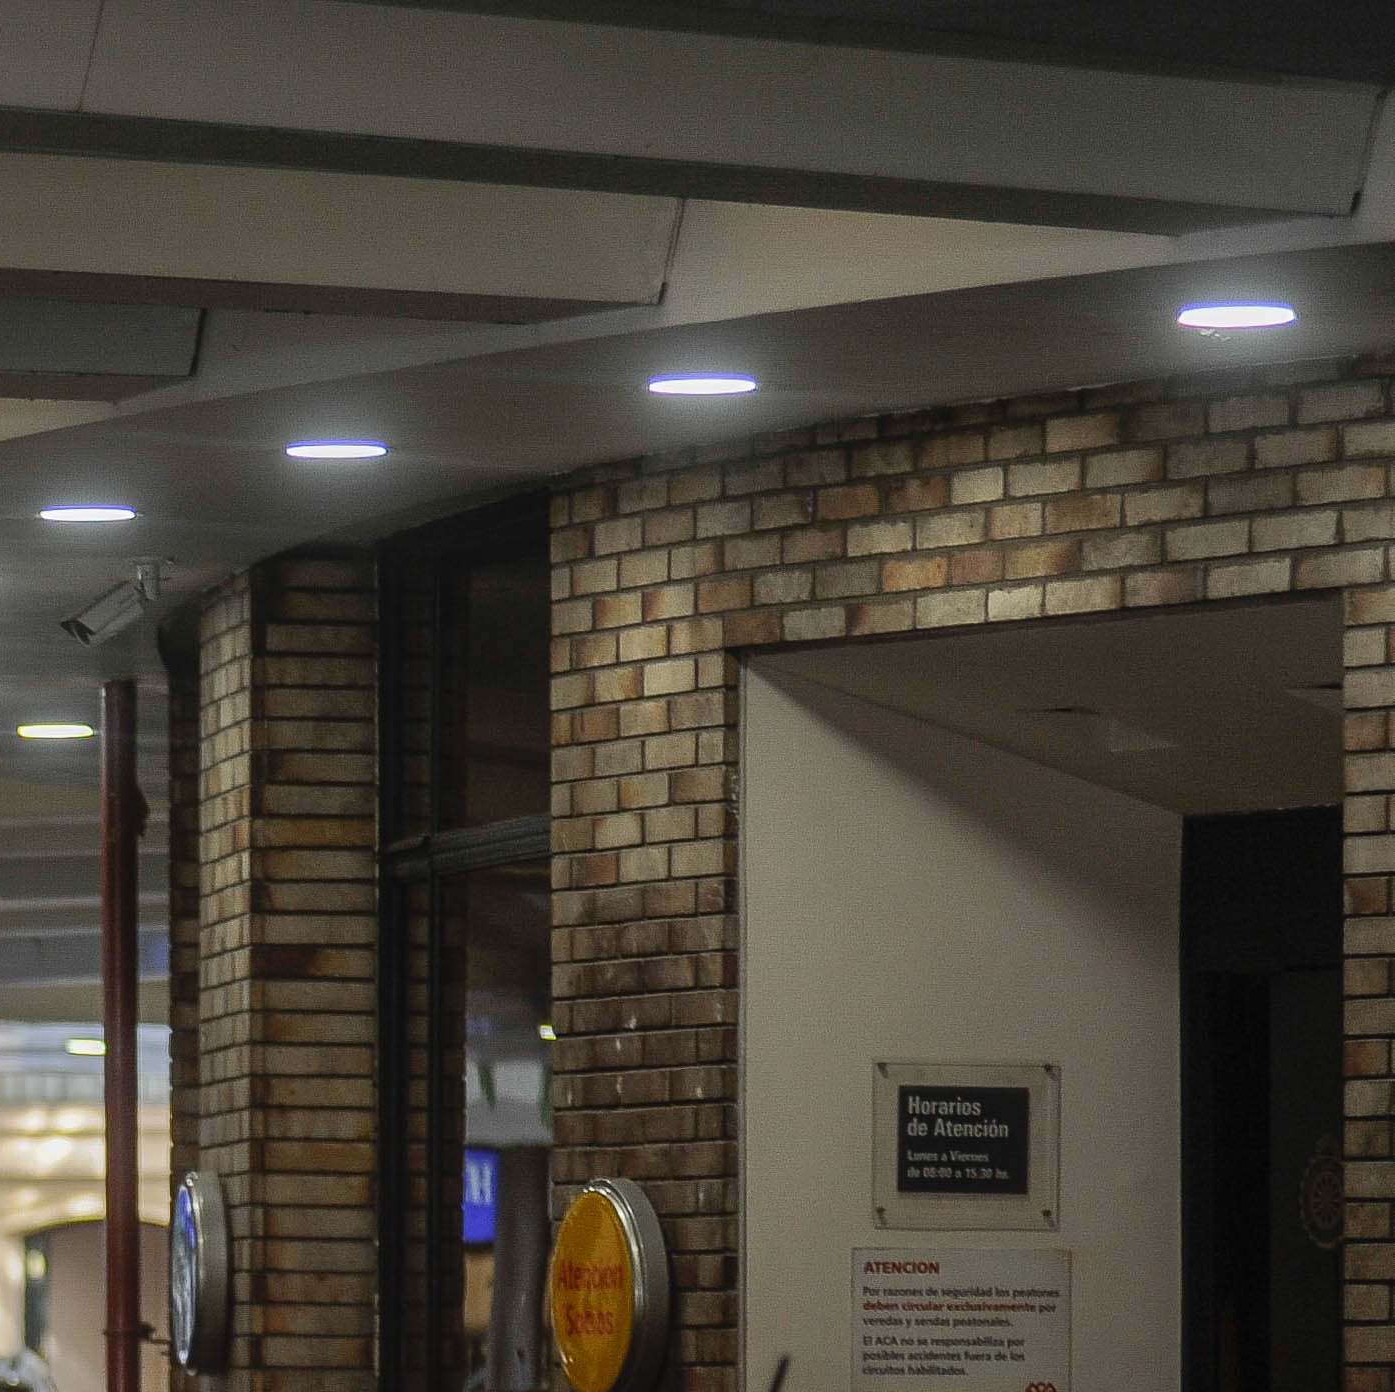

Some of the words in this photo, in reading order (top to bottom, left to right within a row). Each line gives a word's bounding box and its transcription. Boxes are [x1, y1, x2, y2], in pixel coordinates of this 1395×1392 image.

[907, 1095, 982, 1116] Horarios
[907, 1117, 928, 1137] de
[933, 1118, 1009, 1138] Atención
[907, 1149, 938, 1162] Lunes
[941, 1152, 948, 1162] a
[950, 1149, 990, 1163] Viernes
[907, 1166, 920, 1178] de
[955, 1169, 962, 1178] a
[864, 1261, 940, 1274] ATENCION
[863, 1286, 879, 1297] Por
[883, 1288, 923, 1297] razones
[925, 1287, 938, 1297] de
[941, 1287, 993, 1299] seguridad
[995, 1287, 1010, 1298] los
[1013, 1288, 1059, 1300] peatones
[863, 1300, 899, 1311] deben
[902, 1301, 944, 1312] circular
[947, 1301, 1037, 1313] exclusivamente
[1039, 1304, 1057, 1314] por
[863, 1316, 904, 1326] veredas
[915, 1316, 951, 1327] sendas
[953, 1317, 1014, 1329] peatonales.
[863, 1335, 873, 1346] El
[875, 1336, 899, 1346] ACA
[901, 1338, 915, 1346] no
[917, 1338, 928, 1346] se
[931, 1336, 1005, 1348] responsabiliza
[1007, 1338, 1025, 1349] por
[863, 1350, 905, 1362] posibles
[908, 1351, 961, 1361] accidentes
[964, 1351, 992, 1361] fuera
[994, 1351, 1008, 1361] de
[1010, 1351, 1025, 1362] los
[863, 1365, 905, 1376] circuitos
